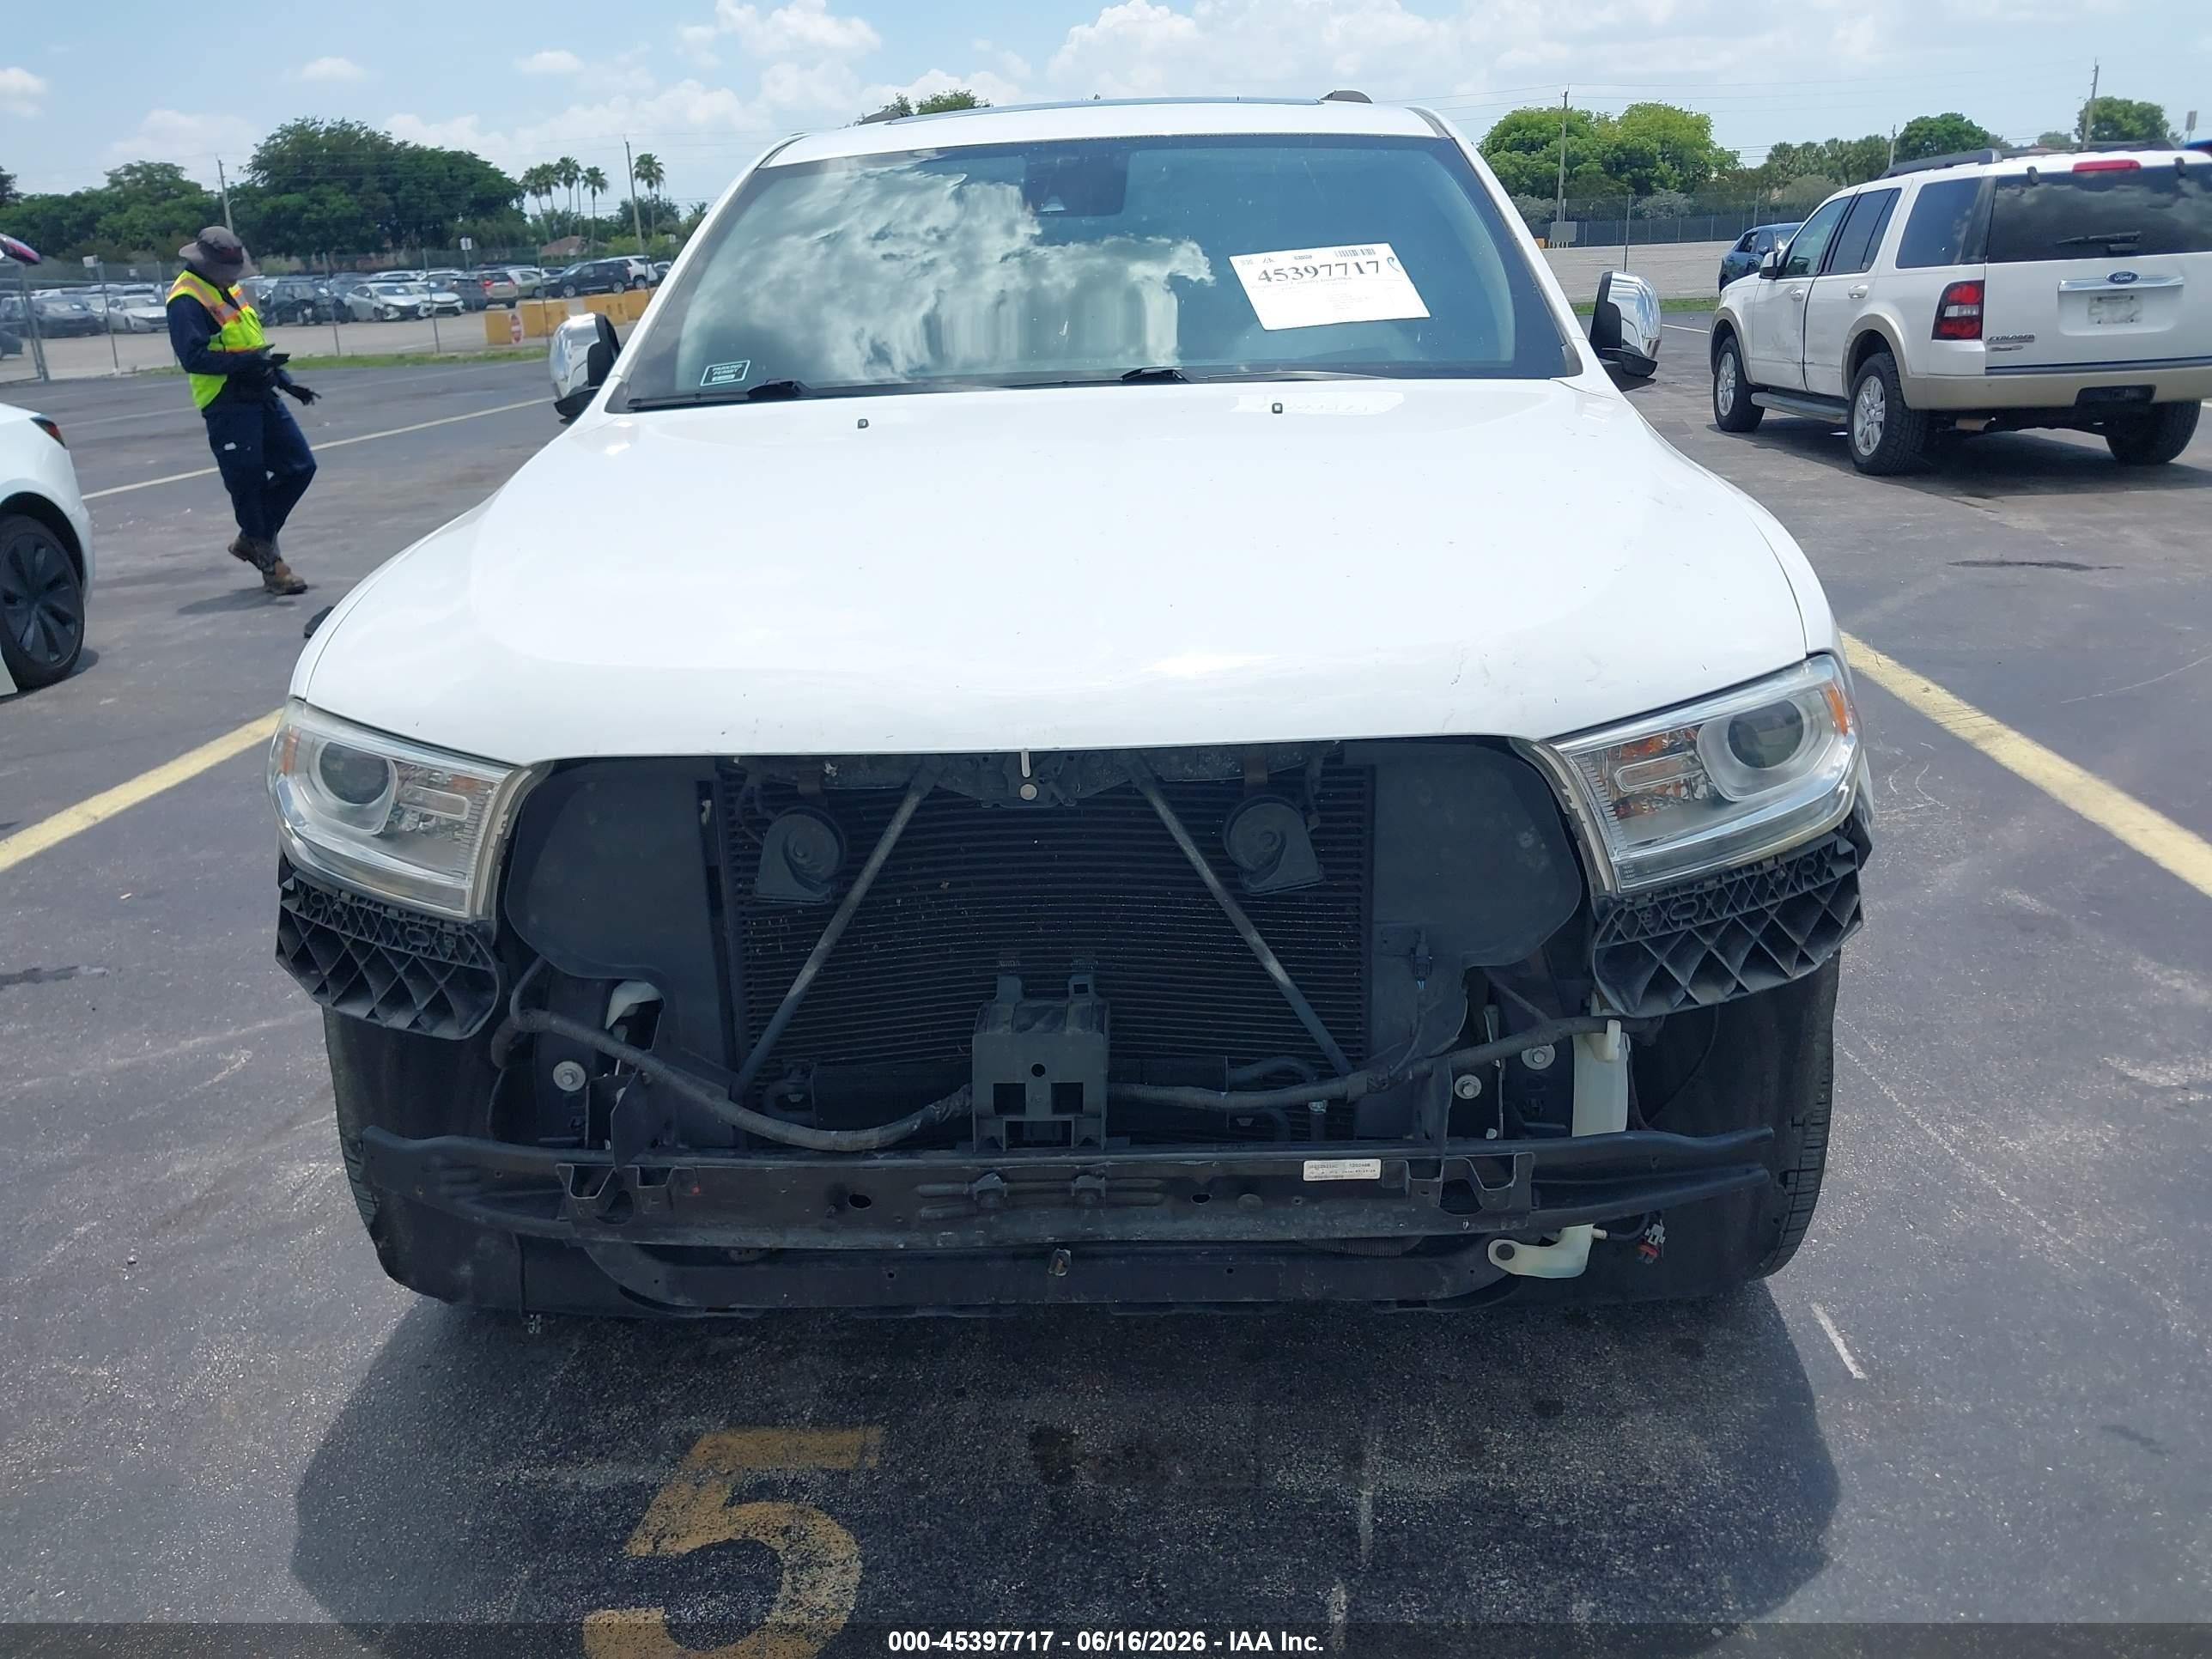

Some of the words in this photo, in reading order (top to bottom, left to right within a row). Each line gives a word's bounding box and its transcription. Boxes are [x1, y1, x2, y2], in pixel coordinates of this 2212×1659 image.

[1257, 260, 1379, 283] 45397717
[2114, 273, 2134, 282] Ford
[581, 1425, 884, 1659] 5
